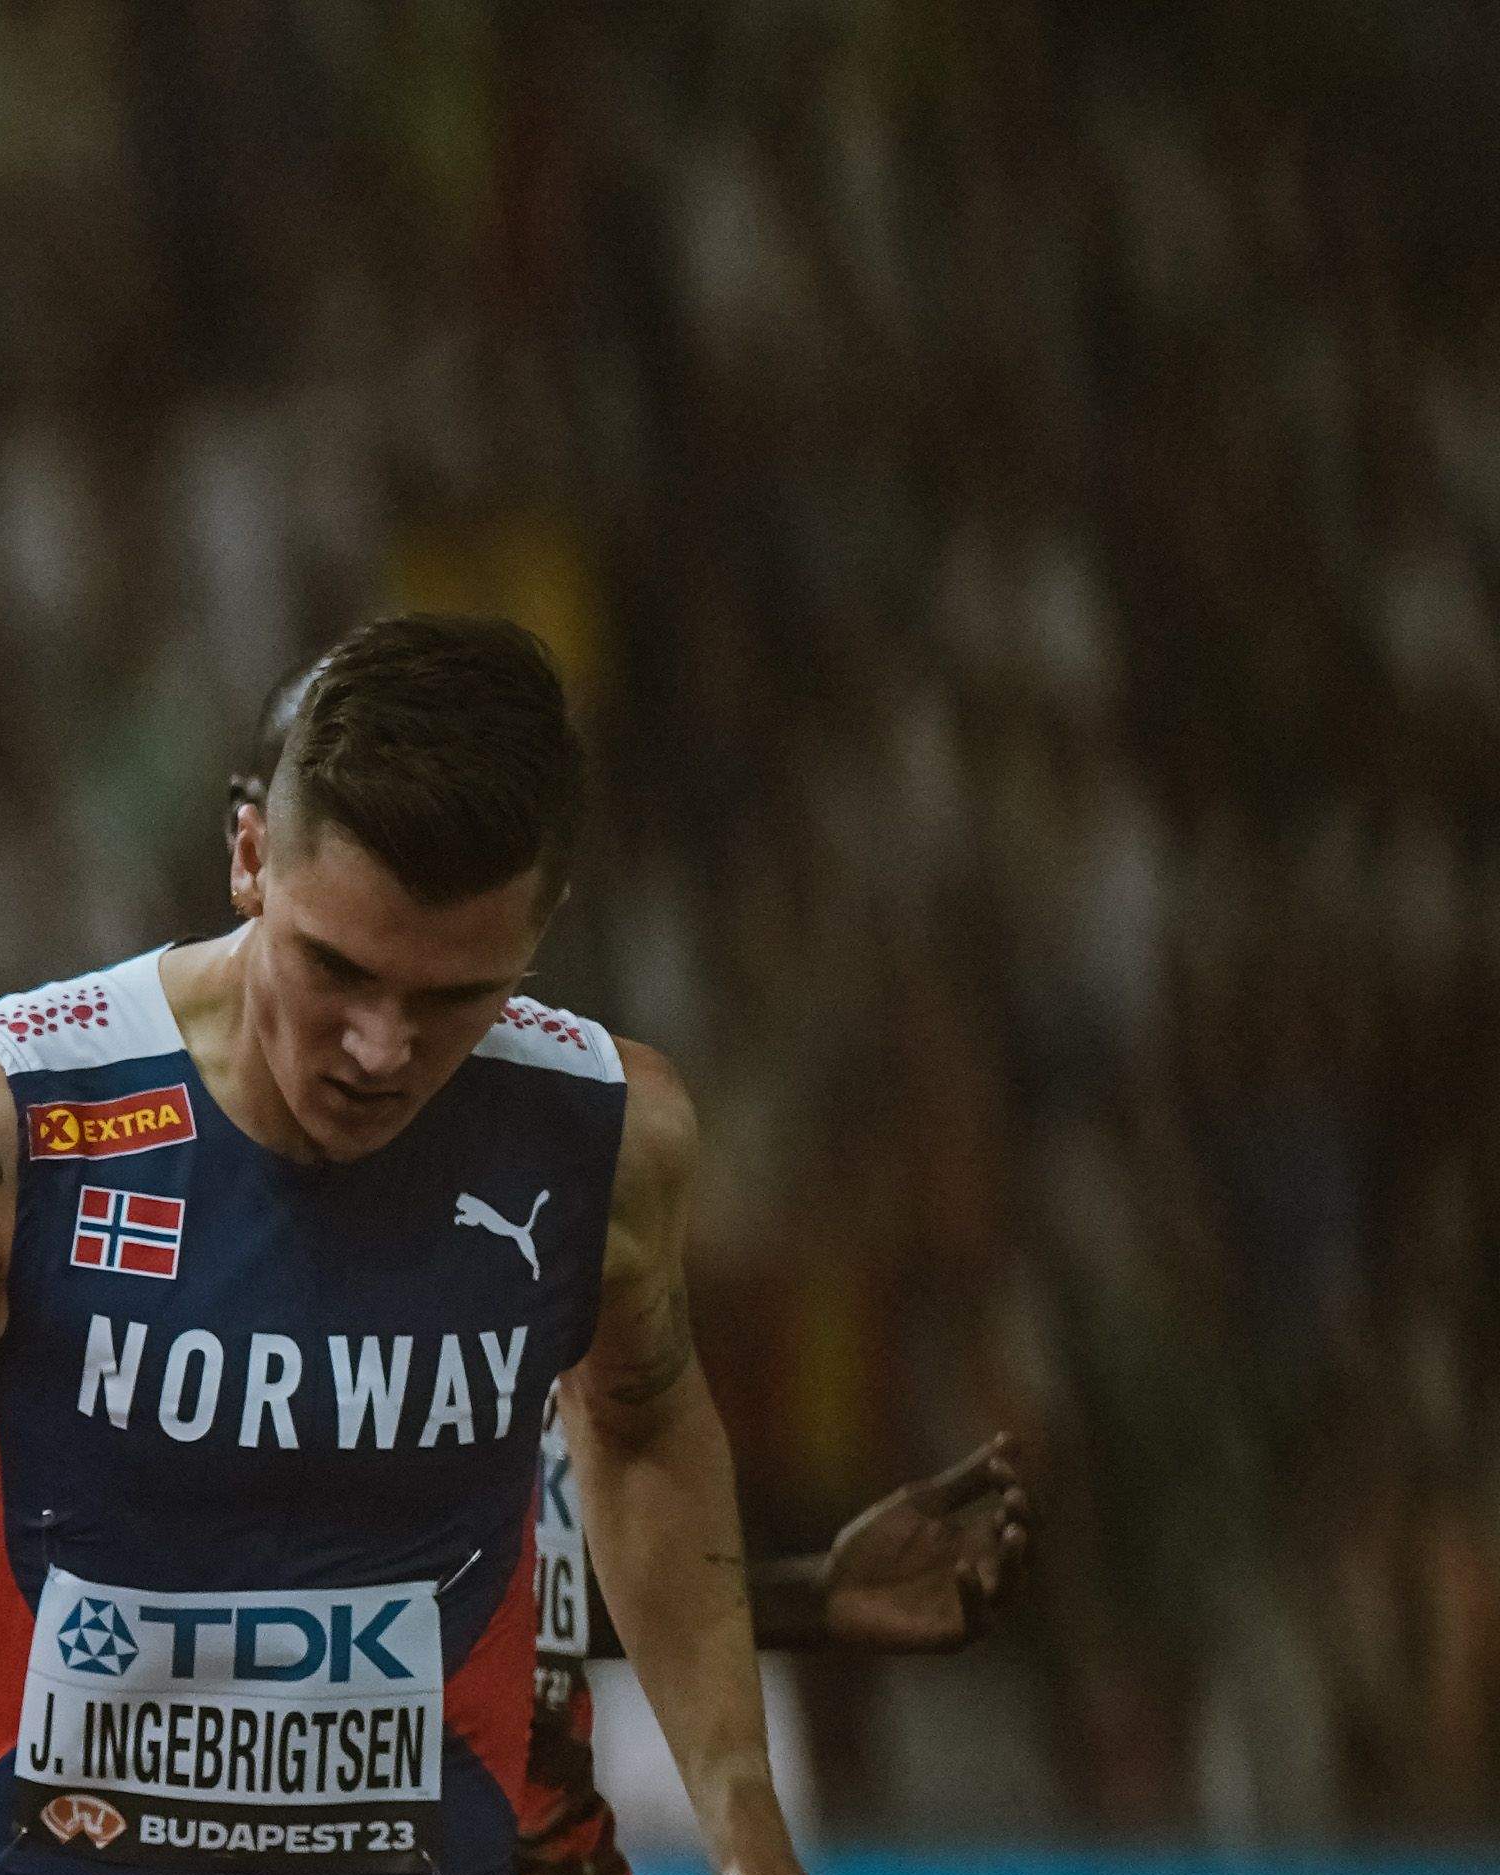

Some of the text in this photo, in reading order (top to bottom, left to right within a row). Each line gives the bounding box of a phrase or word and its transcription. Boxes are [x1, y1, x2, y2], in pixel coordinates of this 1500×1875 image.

[83, 1104, 182, 1143] EXTRA
[78, 1313, 528, 1450] NORWAY
[140, 1601, 416, 1684] TDK
[29, 1691, 425, 1795] J. INGEBRIGTSEN
[139, 1814, 415, 1854] BUDAPEST 23
